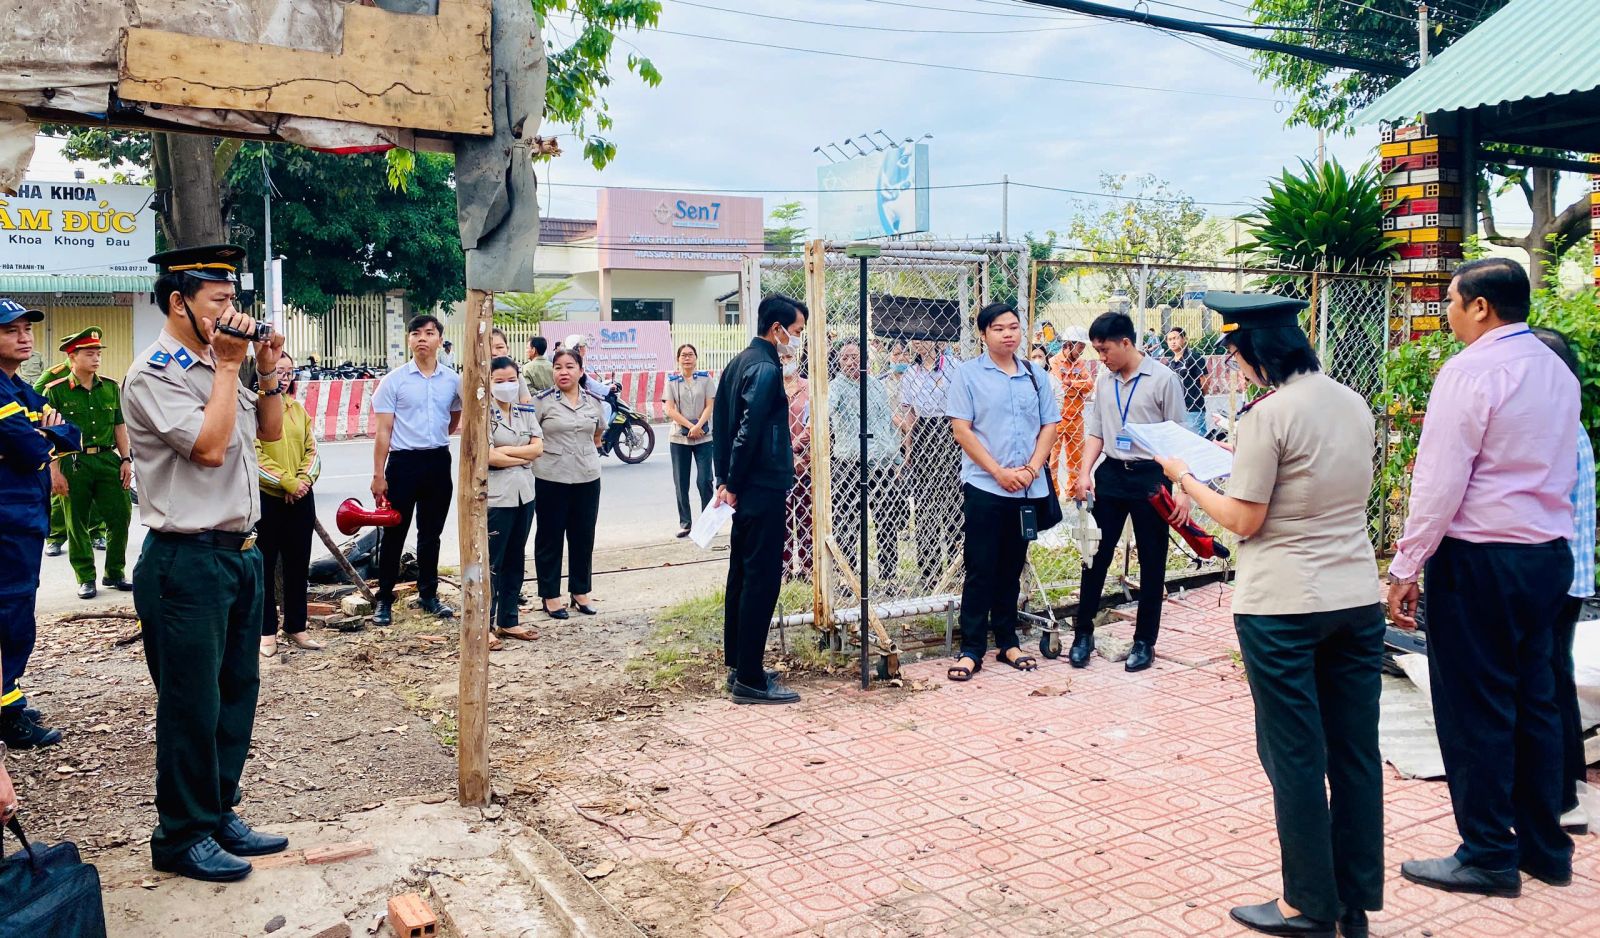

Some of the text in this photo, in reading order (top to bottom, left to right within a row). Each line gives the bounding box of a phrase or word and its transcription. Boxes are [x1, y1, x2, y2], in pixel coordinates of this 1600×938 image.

[5, 184, 96, 201] HA KHOA
[62, 200, 137, 233] ĐỨC
[676, 200, 721, 221] Sen7
[9, 234, 130, 247] Khoa Khong Đau
